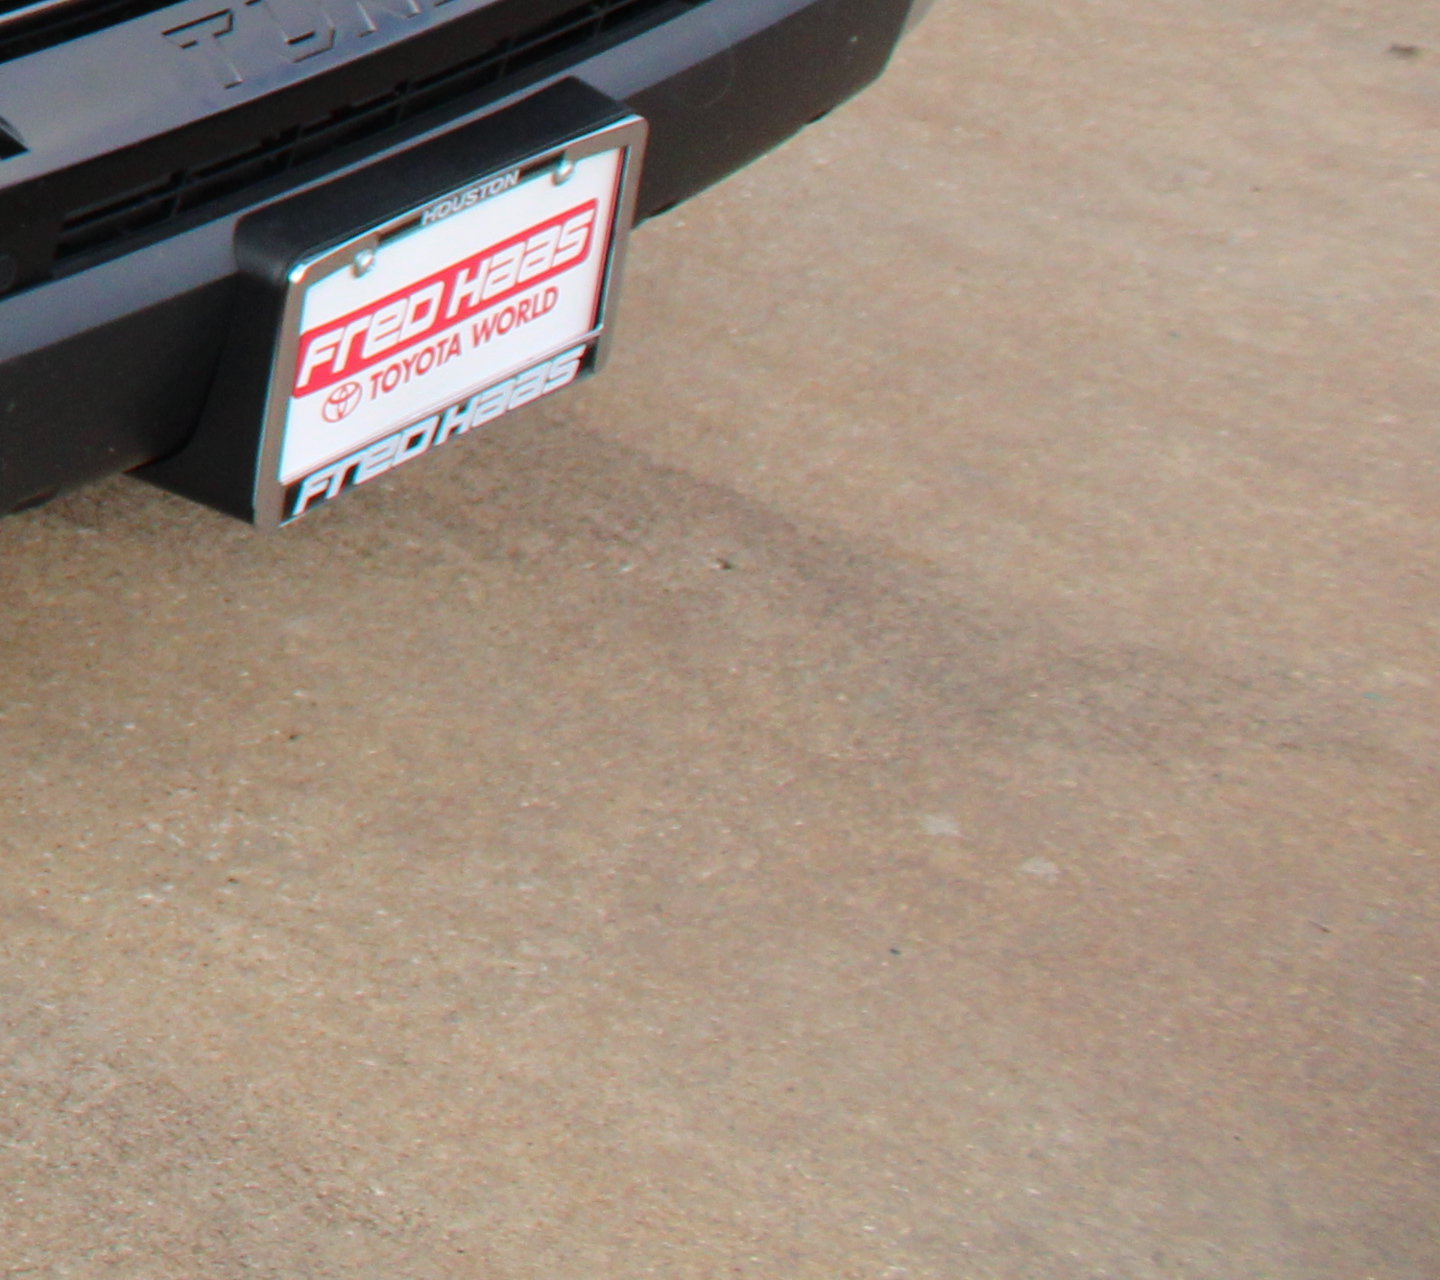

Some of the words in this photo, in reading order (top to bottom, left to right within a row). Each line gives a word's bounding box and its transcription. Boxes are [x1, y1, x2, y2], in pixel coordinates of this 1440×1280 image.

[418, 169, 519, 226] HOUSTON
[368, 339, 461, 402] TOYOTA
[471, 285, 560, 348] WORLD
